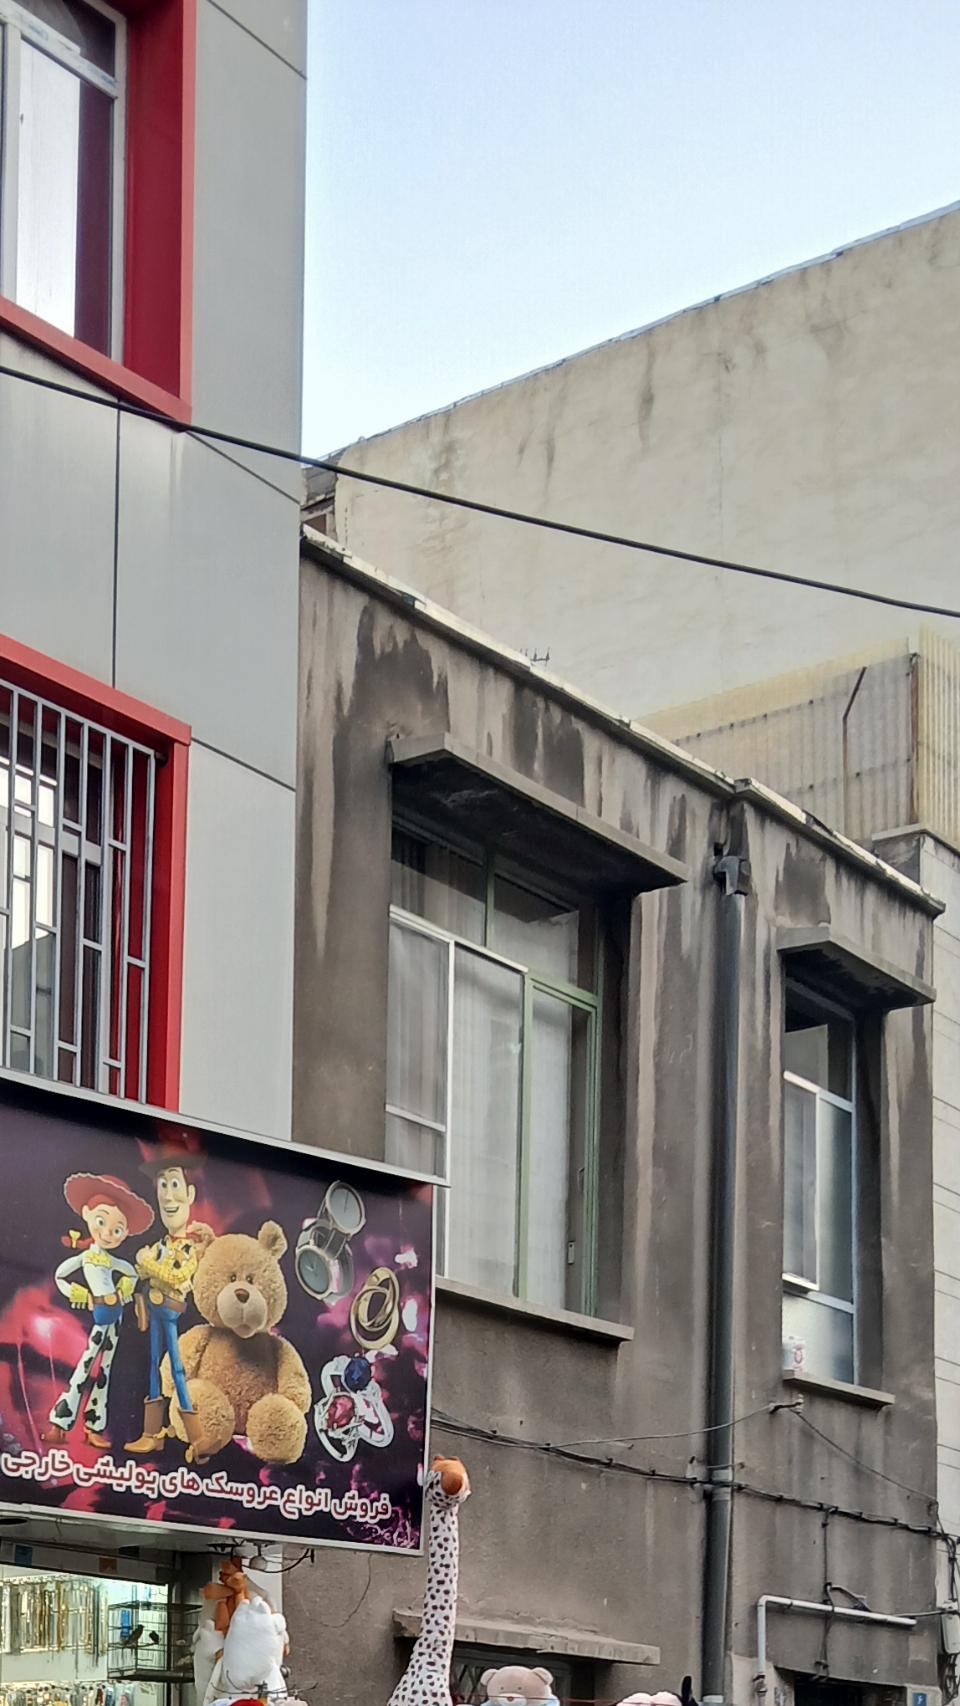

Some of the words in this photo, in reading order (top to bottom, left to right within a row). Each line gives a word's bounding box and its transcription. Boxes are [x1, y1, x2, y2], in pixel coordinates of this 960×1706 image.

[1, 1449, 74, 1481] خارجی
[72, 1455, 159, 1498] پولیشی
[159, 1467, 202, 1499] های
[204, 1471, 280, 1509] عروسک
[280, 1485, 331, 1520] انواع
[331, 1490, 392, 1522] فروش
